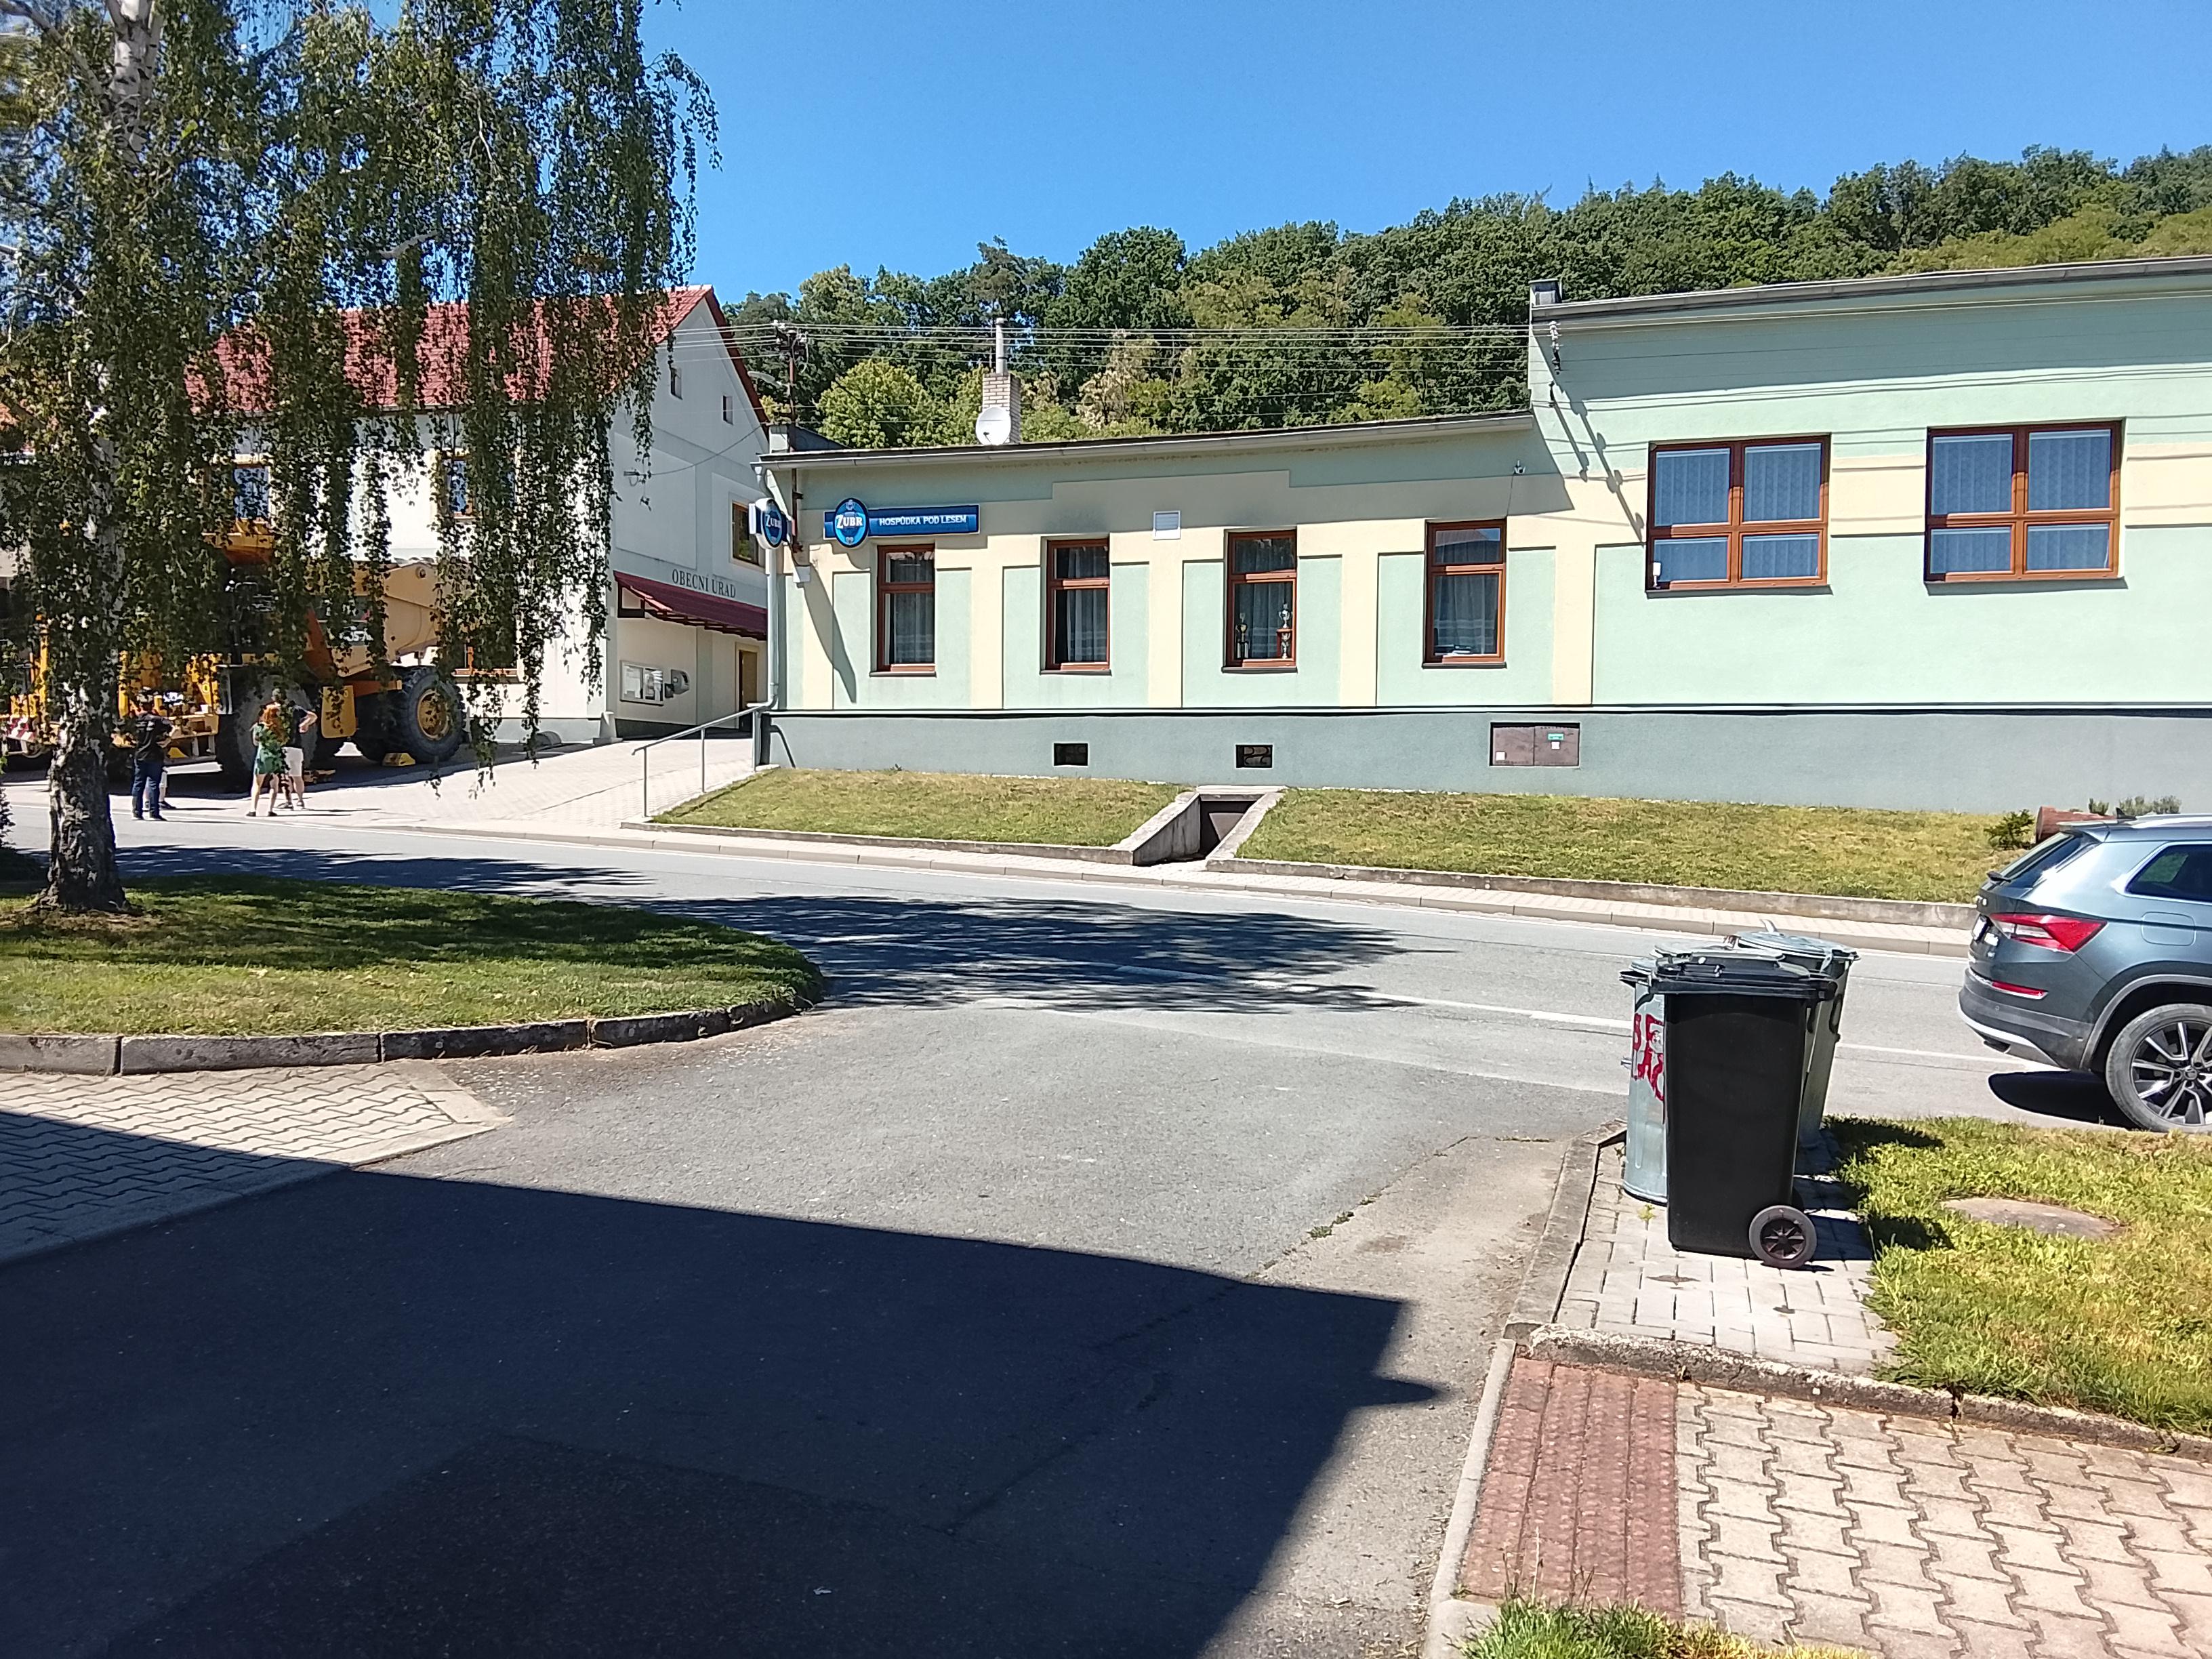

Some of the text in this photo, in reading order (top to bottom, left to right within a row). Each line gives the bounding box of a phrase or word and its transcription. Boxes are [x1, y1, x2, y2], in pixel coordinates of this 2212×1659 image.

[836, 514, 863, 529] ZUBR
[923, 515, 940, 524] POD
[941, 514, 966, 524] LESEM
